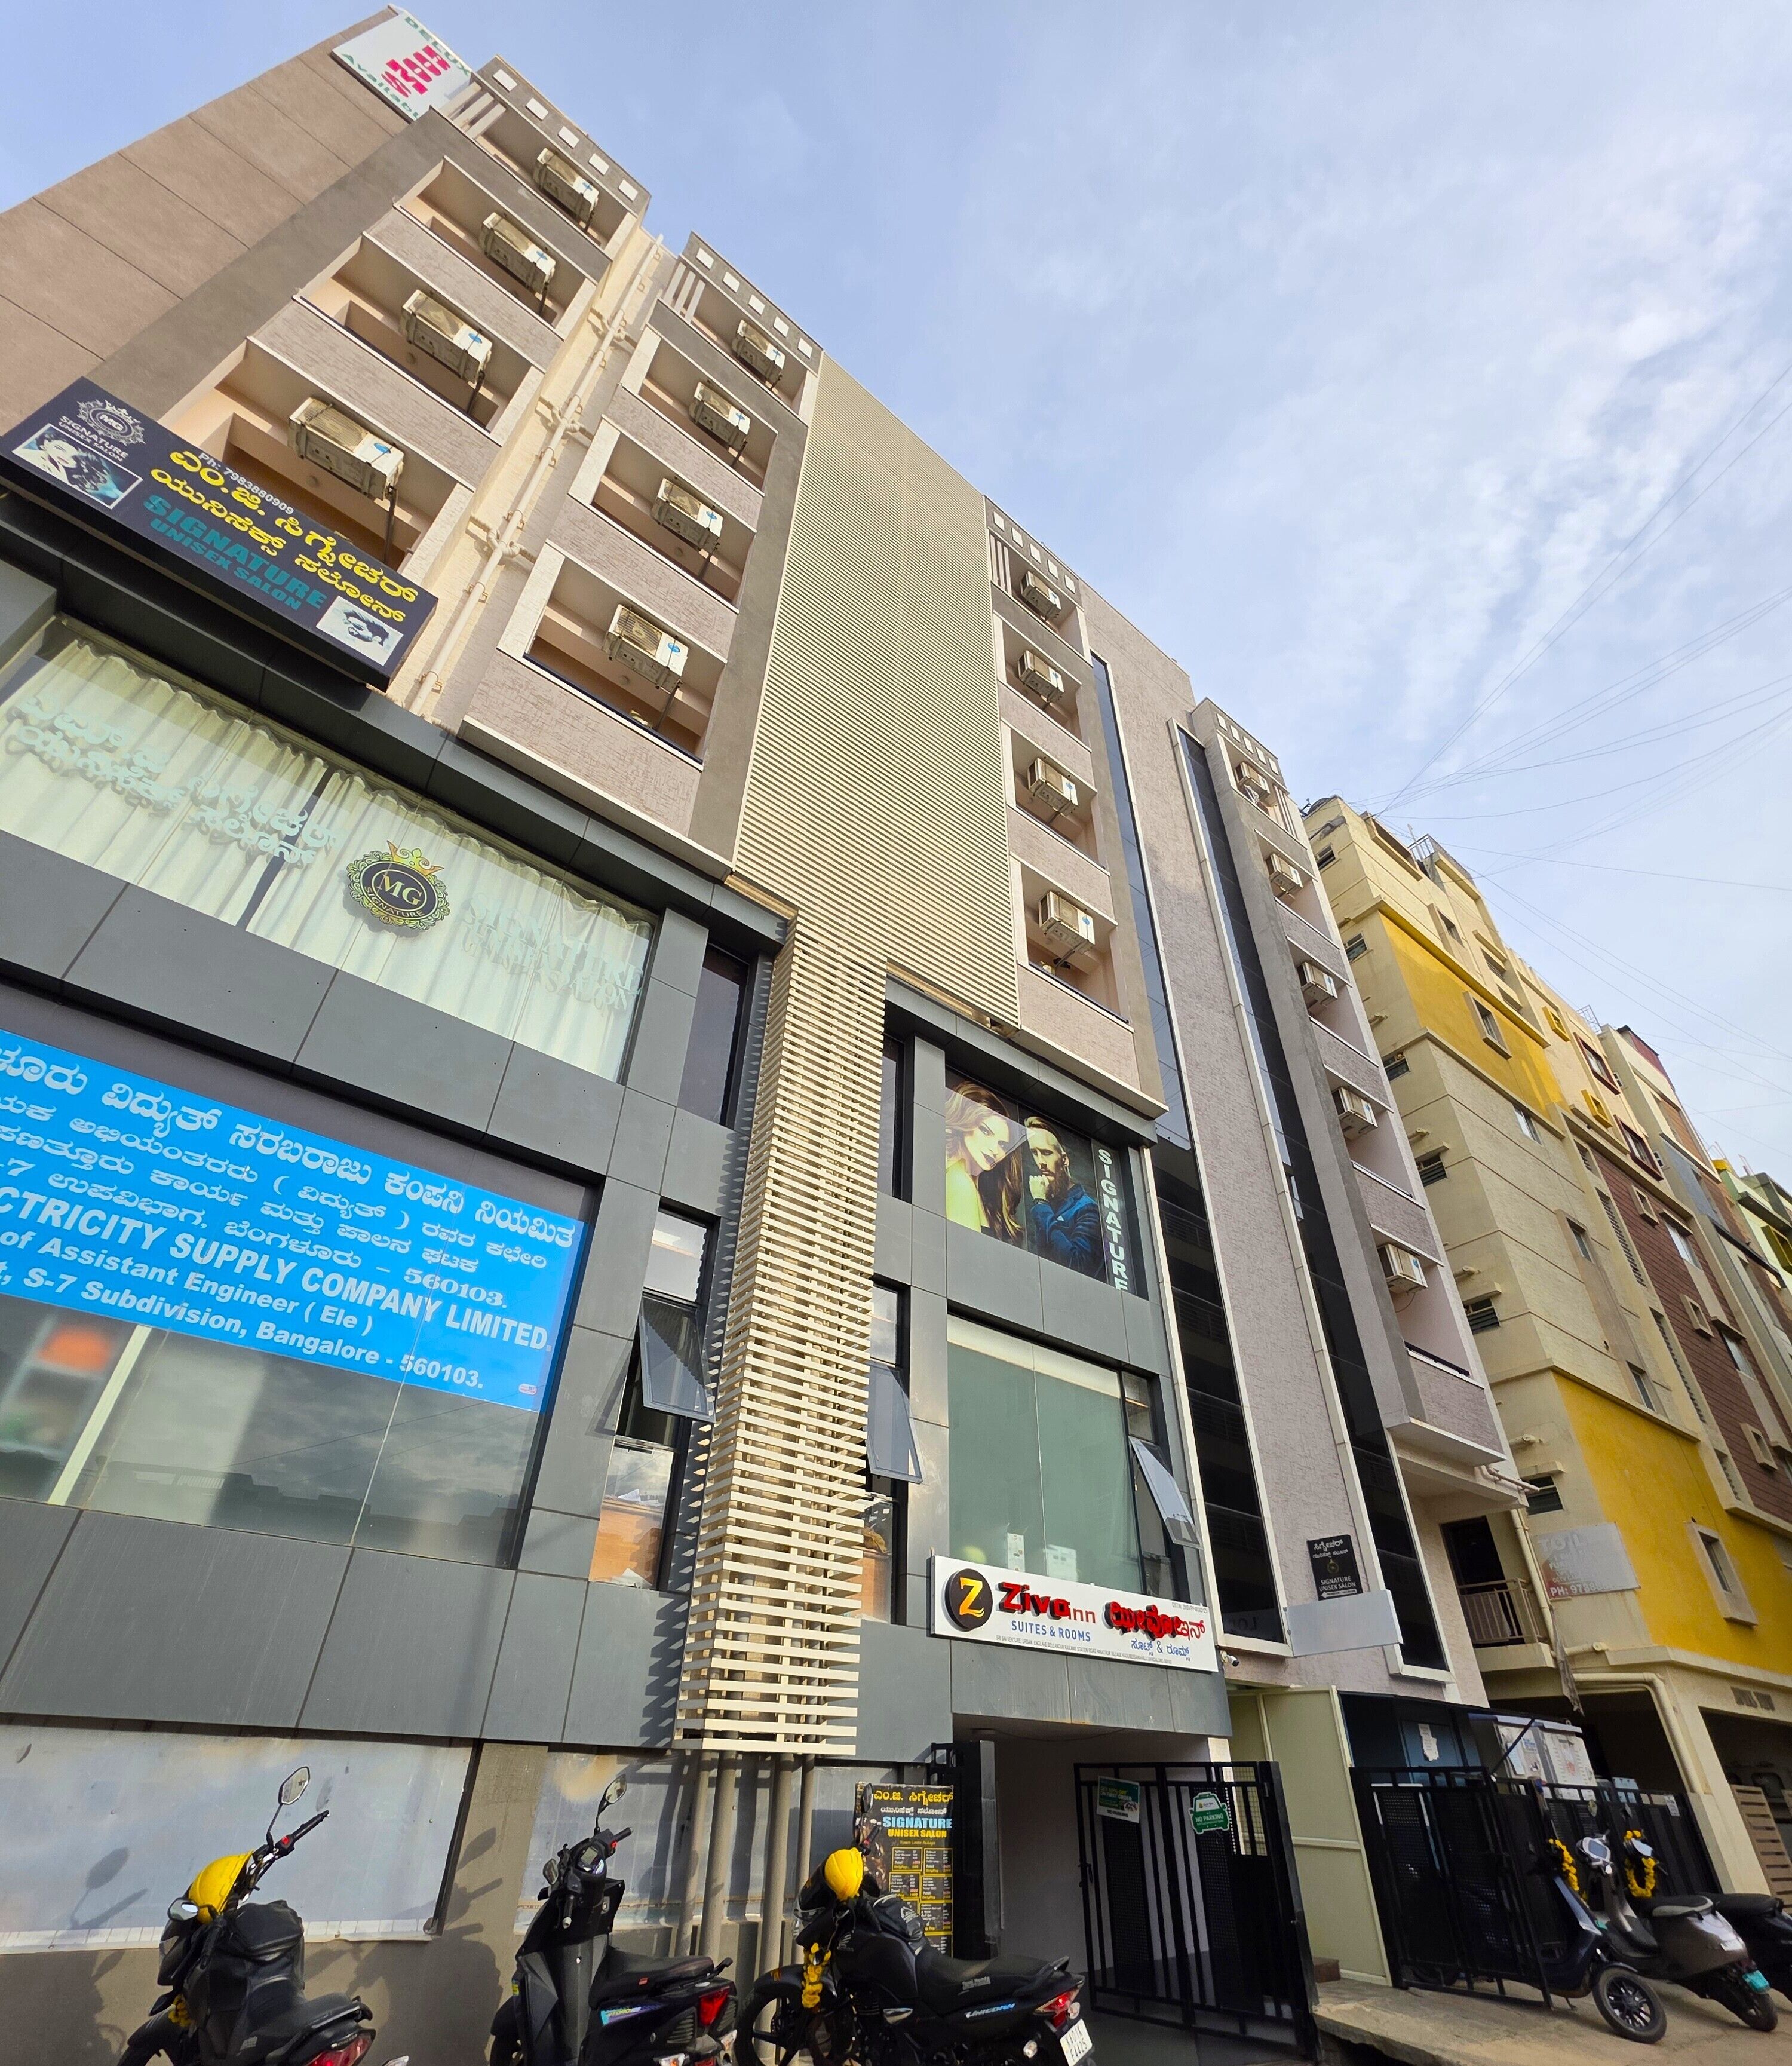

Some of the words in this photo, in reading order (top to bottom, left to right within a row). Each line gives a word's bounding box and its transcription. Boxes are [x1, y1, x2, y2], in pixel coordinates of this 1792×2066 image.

[381, 45, 451, 98] ROOMS
[58, 421, 93, 444] UNISEX
[92, 442, 124, 462] SALON
[60, 415, 129, 459] SIGNATURE
[99, 414, 124, 431] MG
[198, 452, 222, 468] Ph:
[223, 467, 294, 515] 7983880909
[143, 494, 328, 610] SIGNATURE
[149, 517, 234, 571] UNISEX
[234, 566, 302, 611] SALON
[151, 468, 287, 557] ಯುನಿಸೆಕ್ಸ್
[294, 553, 406, 623] ಸಲೋನ್
[274, 516, 419, 602] ಸಿಗ್ನೇಚರ್
[364, 885, 425, 918] SIGNATURE
[381, 873, 423, 907] MG
[69, 1117, 259, 1183] ಅಭಿಯಂತರರು
[297, 1185, 387, 1220] ವಿದ್ಯುತ್
[101, 1083, 222, 1138] ವಿದ್ಯುತ್
[228, 1122, 372, 1185] ಸರಬರಾಜು
[384, 1170, 464, 1215] ಕಂಪನಿ
[474, 1200, 576, 1248] ನಿಯಮಿತ
[47, 1172, 208, 1229] ಉಪವಿಭಾಗ,
[223, 1220, 362, 1268] ಬೆಂಗಳೂರು
[403, 1268, 508, 1309] 560103.
[260, 1201, 324, 1236] ಮತ್ತು
[337, 1223, 412, 1254] ಪಾಲನ
[0, 1231, 38, 1250] of
[37, 1237, 179, 1286] Assistant
[183, 1271, 300, 1314] Engineer
[319, 1304, 359, 1329] Ele
[169, 1232, 299, 1285] SUPPLY
[301, 1267, 443, 1322] COMPANY
[444, 1304, 553, 1353] LIMITED.
[23, 1267, 78, 1293] S-7
[81, 1280, 248, 1339] Subdivision,
[255, 1320, 381, 1365] Bangalore
[398, 1353, 484, 1390] 560103.
[959, 1577, 985, 1618] Z
[1320, 1575, 1352, 1586] SIGNATURE
[1549, 1585, 1569, 1597] PH:
[1011, 1620, 1047, 1636] SUITES
[1050, 1626, 1057, 1637] &
[1058, 1627, 1092, 1642] ROOMS
[1156, 1640, 1164, 1653] &
[909, 1790, 954, 1806] ಸಿಗ್ನೇಚರ್
[1202, 1813, 1224, 1822] PARKING
[882, 1816, 953, 1829] SIGNATURE
[888, 1829, 919, 1838] UNISEX
[920, 1829, 947, 1838] SALON
